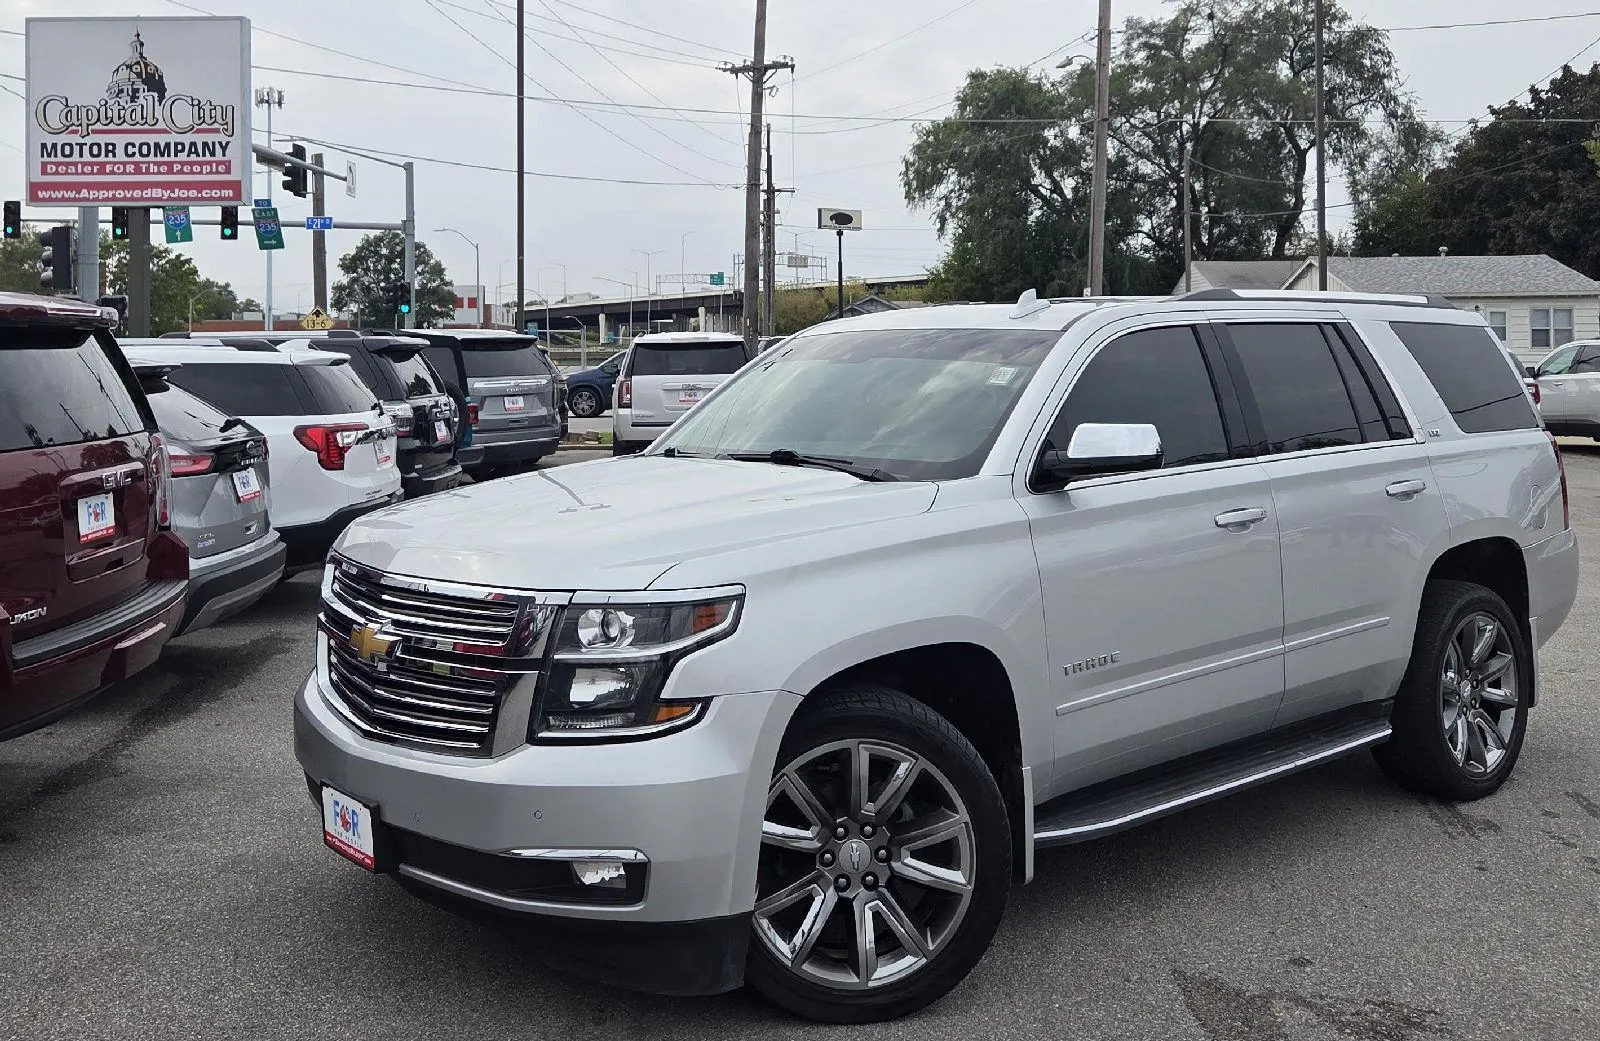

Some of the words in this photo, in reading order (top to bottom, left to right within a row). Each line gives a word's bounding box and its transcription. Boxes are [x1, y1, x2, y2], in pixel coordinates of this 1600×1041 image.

[35, 93, 159, 138] Capital
[162, 95, 235, 138] City
[40, 142, 117, 159] MOTOR
[124, 141, 231, 158] COMPANY
[46, 164, 100, 174] Dealer
[105, 165, 135, 173] FOR
[140, 163, 169, 173] The
[173, 163, 226, 174] People
[37, 188, 234, 199] www.ApprovedByJoe.com
[168, 214, 187, 225] 235
[255, 210, 275, 218] EAST
[259, 223, 277, 232] 235
[9, 606, 47, 625] UKON
[1062, 650, 1120, 677] TAHOE
